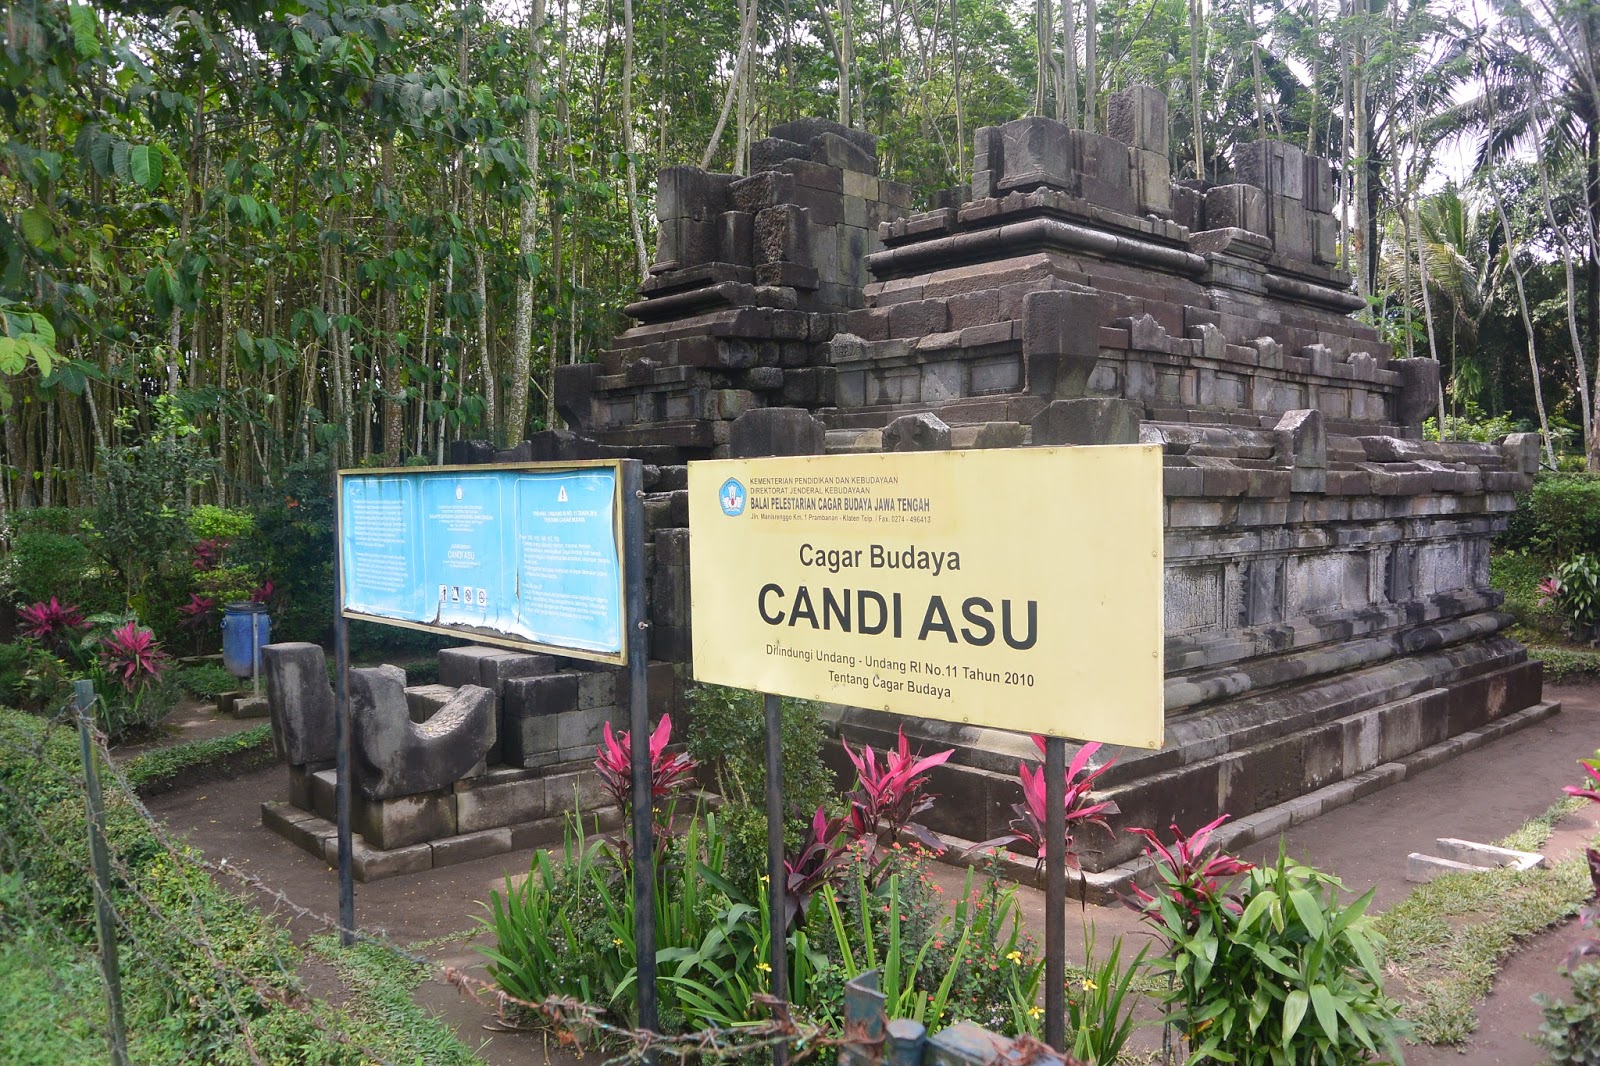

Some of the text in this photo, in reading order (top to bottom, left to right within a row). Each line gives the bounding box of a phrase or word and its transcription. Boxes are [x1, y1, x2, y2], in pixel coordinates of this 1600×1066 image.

[750, 477, 793, 485] KEMENTERIAN
[851, 476, 898, 484] KEBUDAYAAN
[751, 497, 930, 512] BALAI PELESTARIAN CAGAR BUDAYA JAWA TENGAH
[842, 514, 860, 522] Klaten
[891, 515, 905, 523] 0274
[799, 543, 961, 577] Cagar Budaya
[758, 583, 1038, 650] CANDI ASU
[766, 644, 813, 662] Dilindungi
[816, 651, 856, 668] Undang
[865, 656, 906, 674] Undang
[910, 661, 921, 674] RI
[962, 666, 1000, 683] Tahun
[1004, 671, 1034, 688] 2010
[828, 670, 951, 700] Tentang Cagar Budaya
